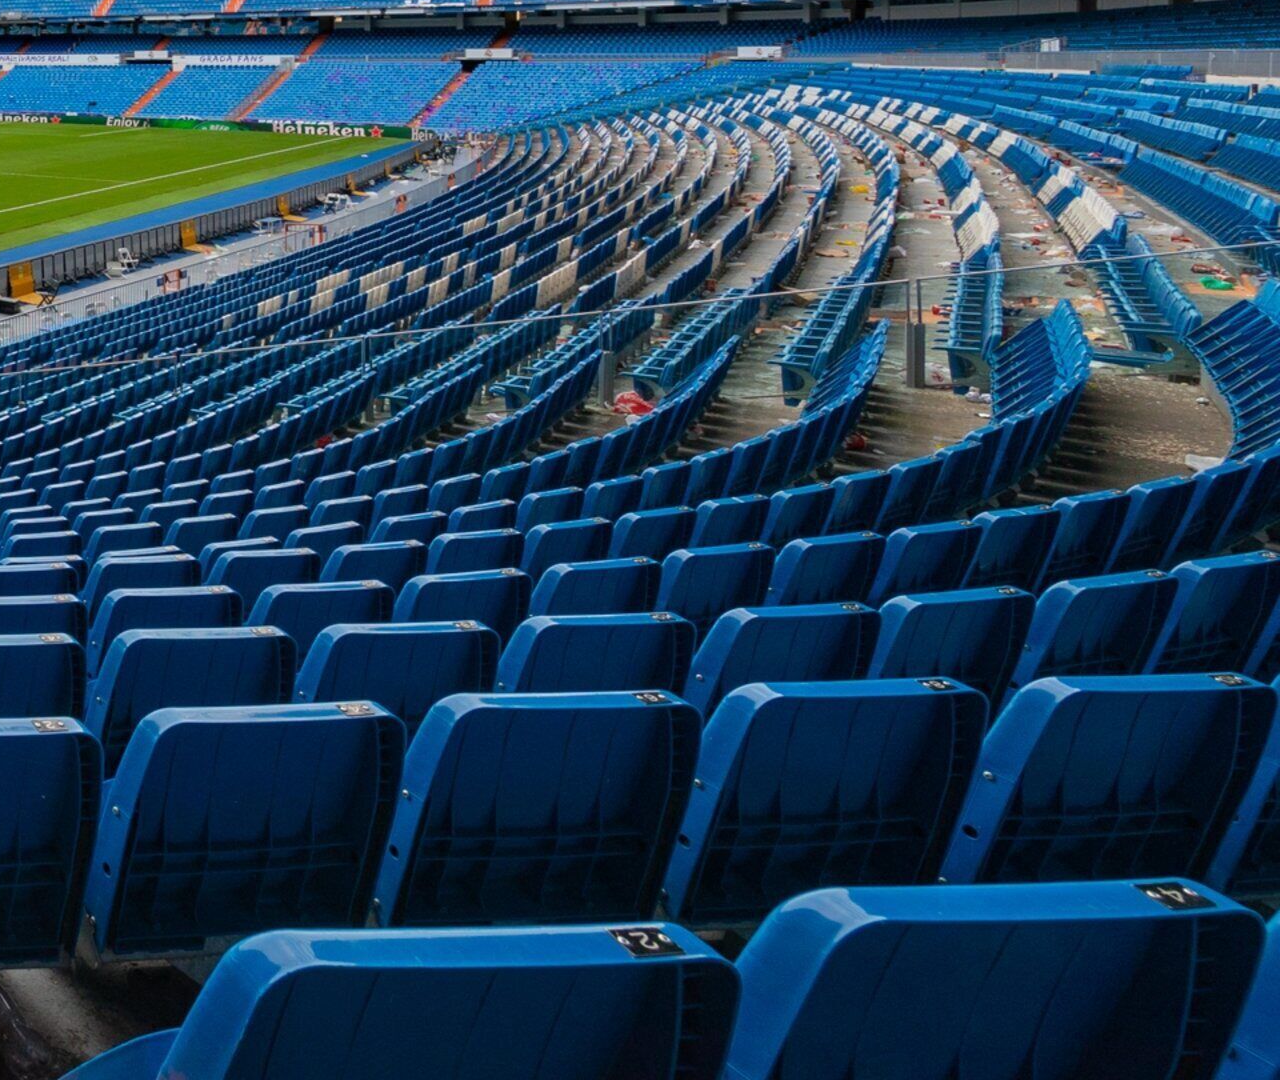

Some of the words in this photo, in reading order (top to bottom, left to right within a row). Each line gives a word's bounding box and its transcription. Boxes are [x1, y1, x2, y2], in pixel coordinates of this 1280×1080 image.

[272, 120, 367, 137] Heineken
[1156, 886, 1185, 903] 4
[627, 931, 660, 950] 2
